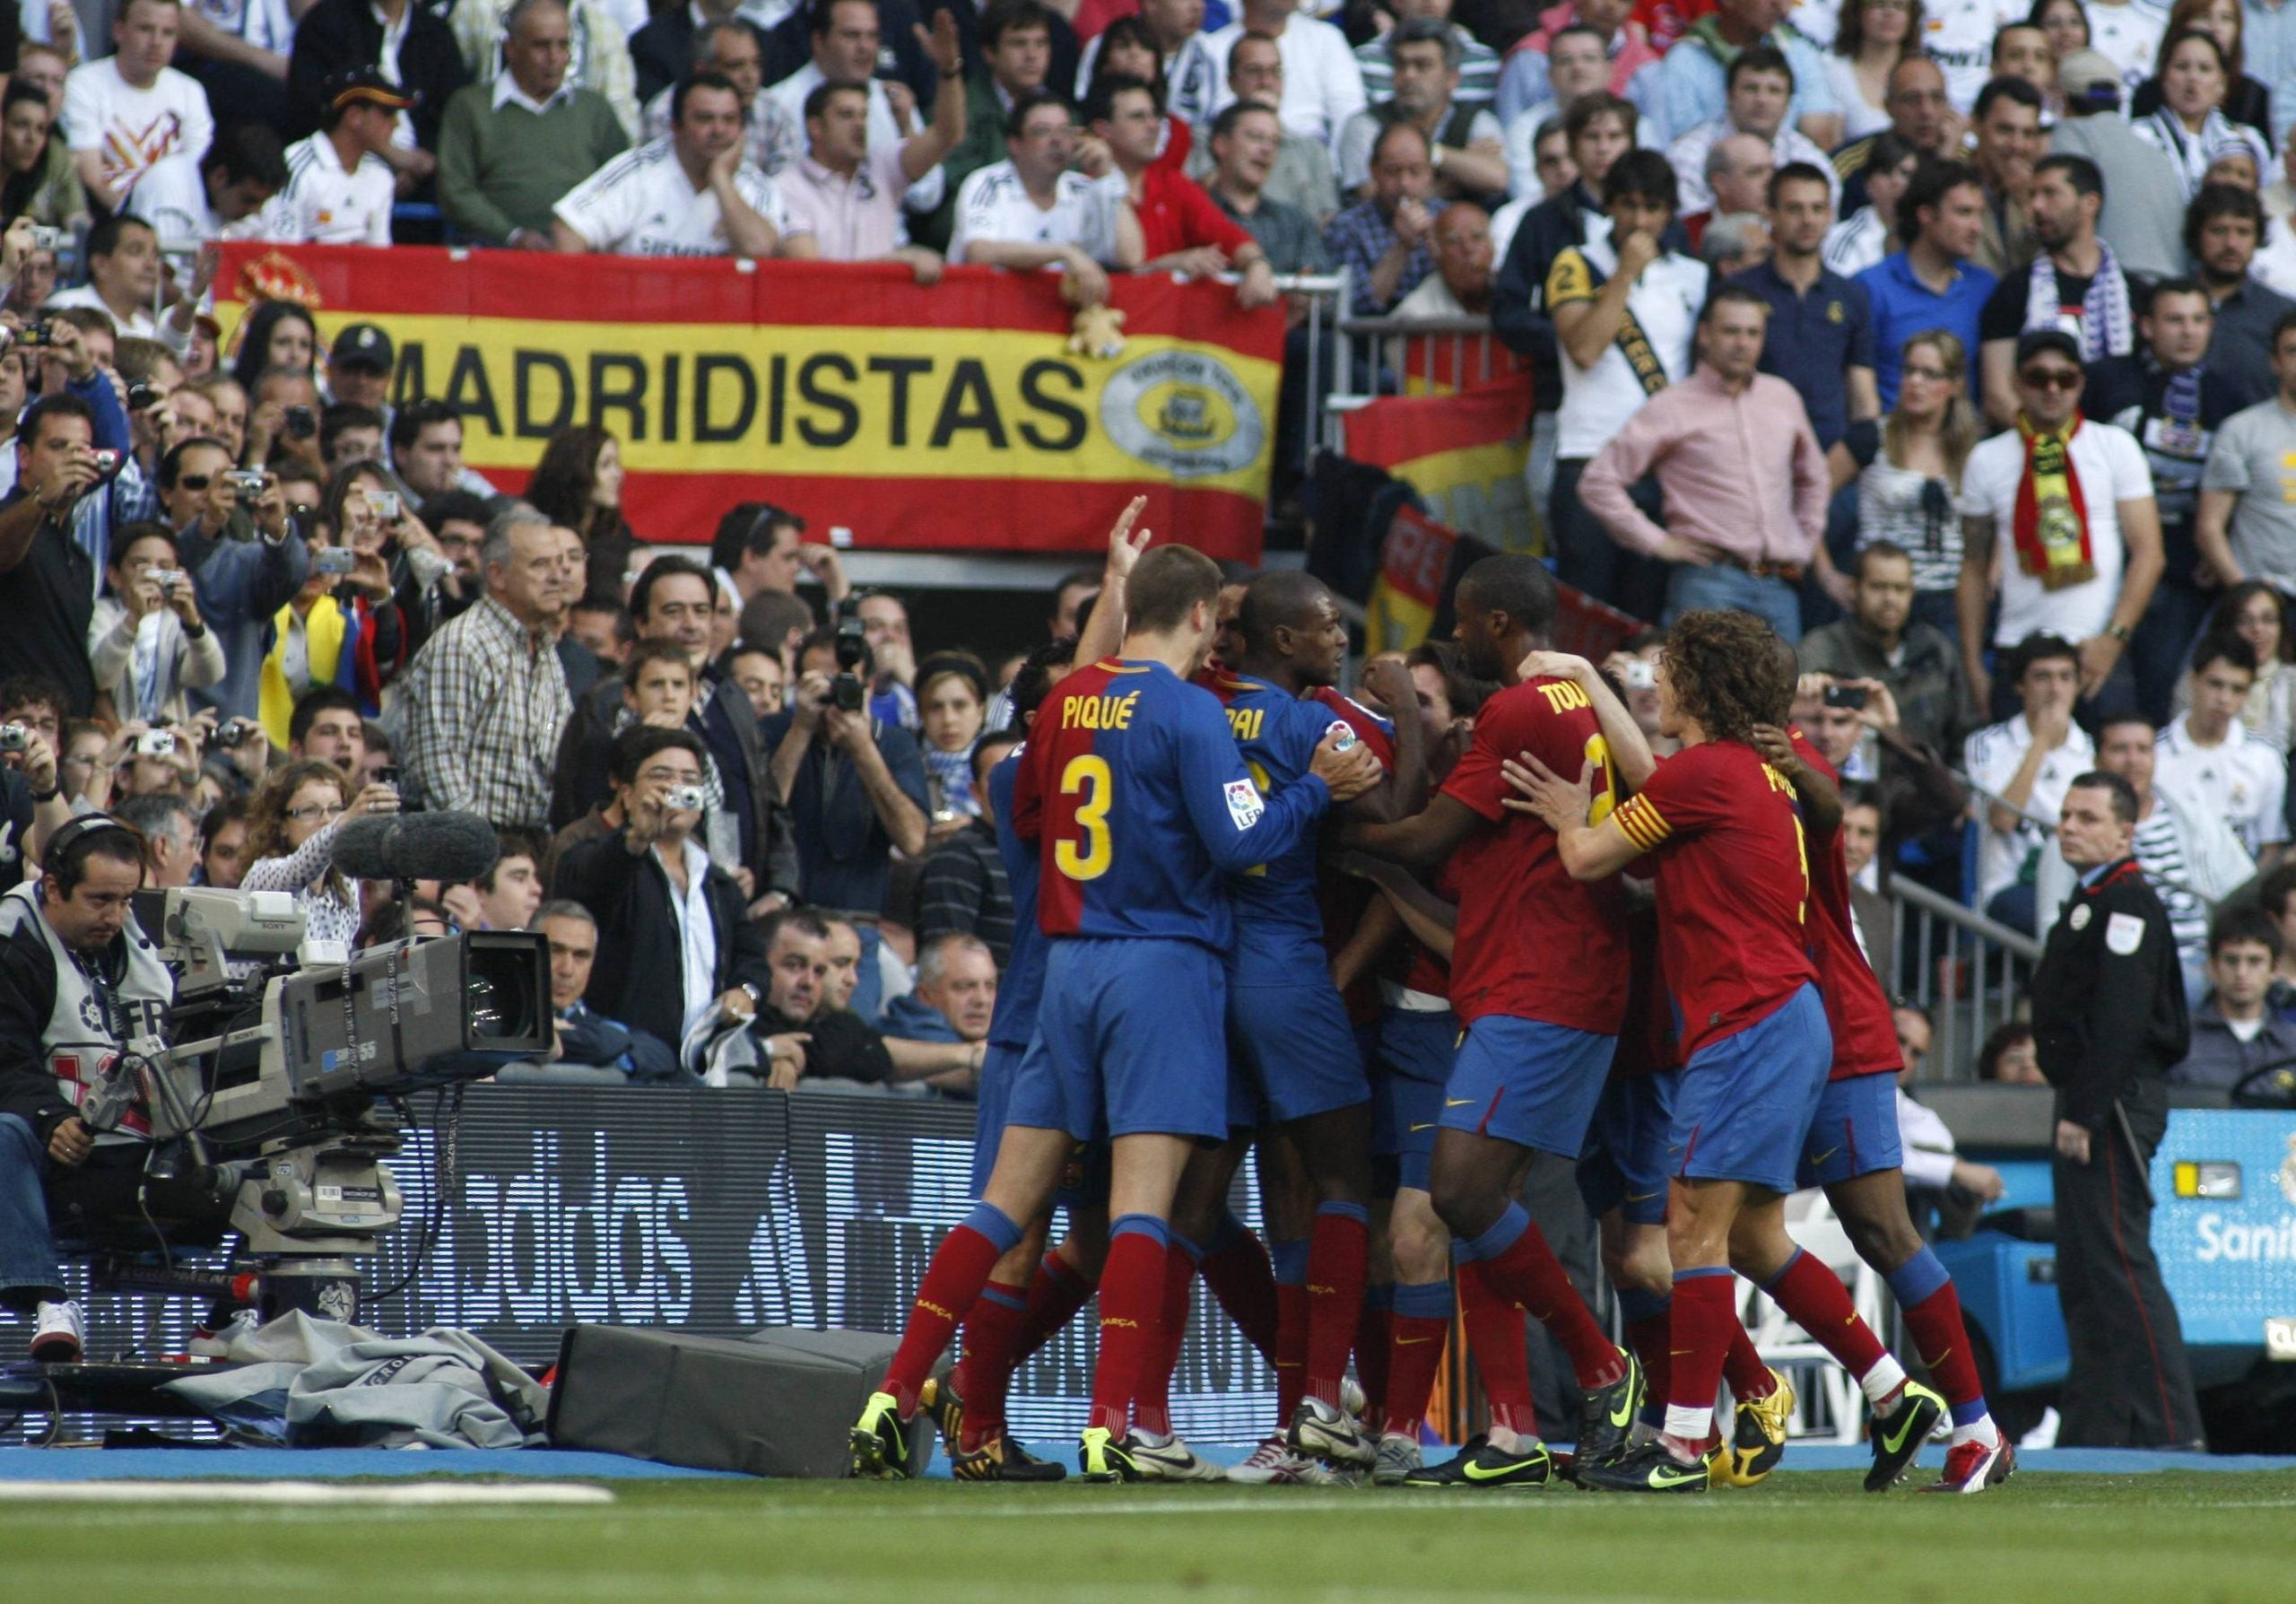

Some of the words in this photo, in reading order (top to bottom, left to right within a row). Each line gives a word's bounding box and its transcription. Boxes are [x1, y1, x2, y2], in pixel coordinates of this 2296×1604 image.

[1062, 690, 1142, 729] PIQUÉ
[1055, 754, 1112, 880] 3
[262, 920, 286, 930] SONY
